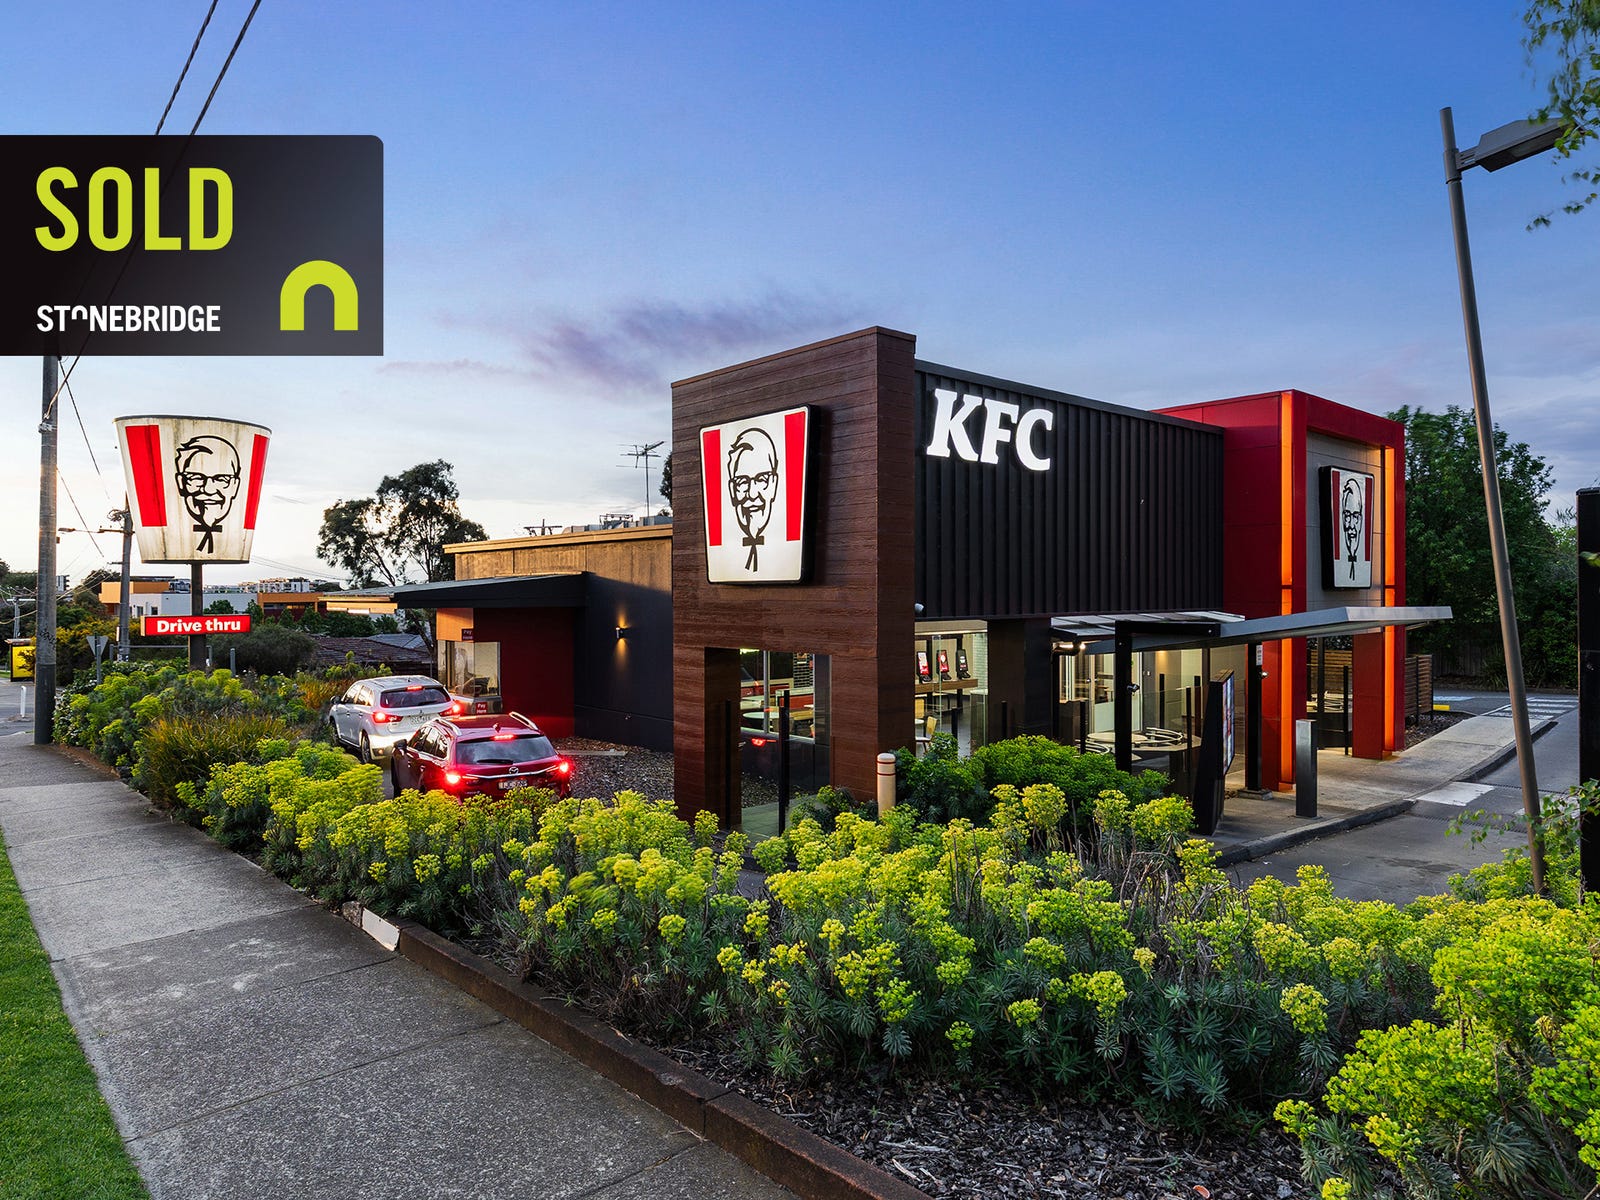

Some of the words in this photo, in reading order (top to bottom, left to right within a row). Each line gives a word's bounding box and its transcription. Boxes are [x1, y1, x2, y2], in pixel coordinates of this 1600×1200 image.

[926, 388, 1053, 471] KFC
[156, 619, 202, 633] Drive
[205, 618, 241, 631] thru
